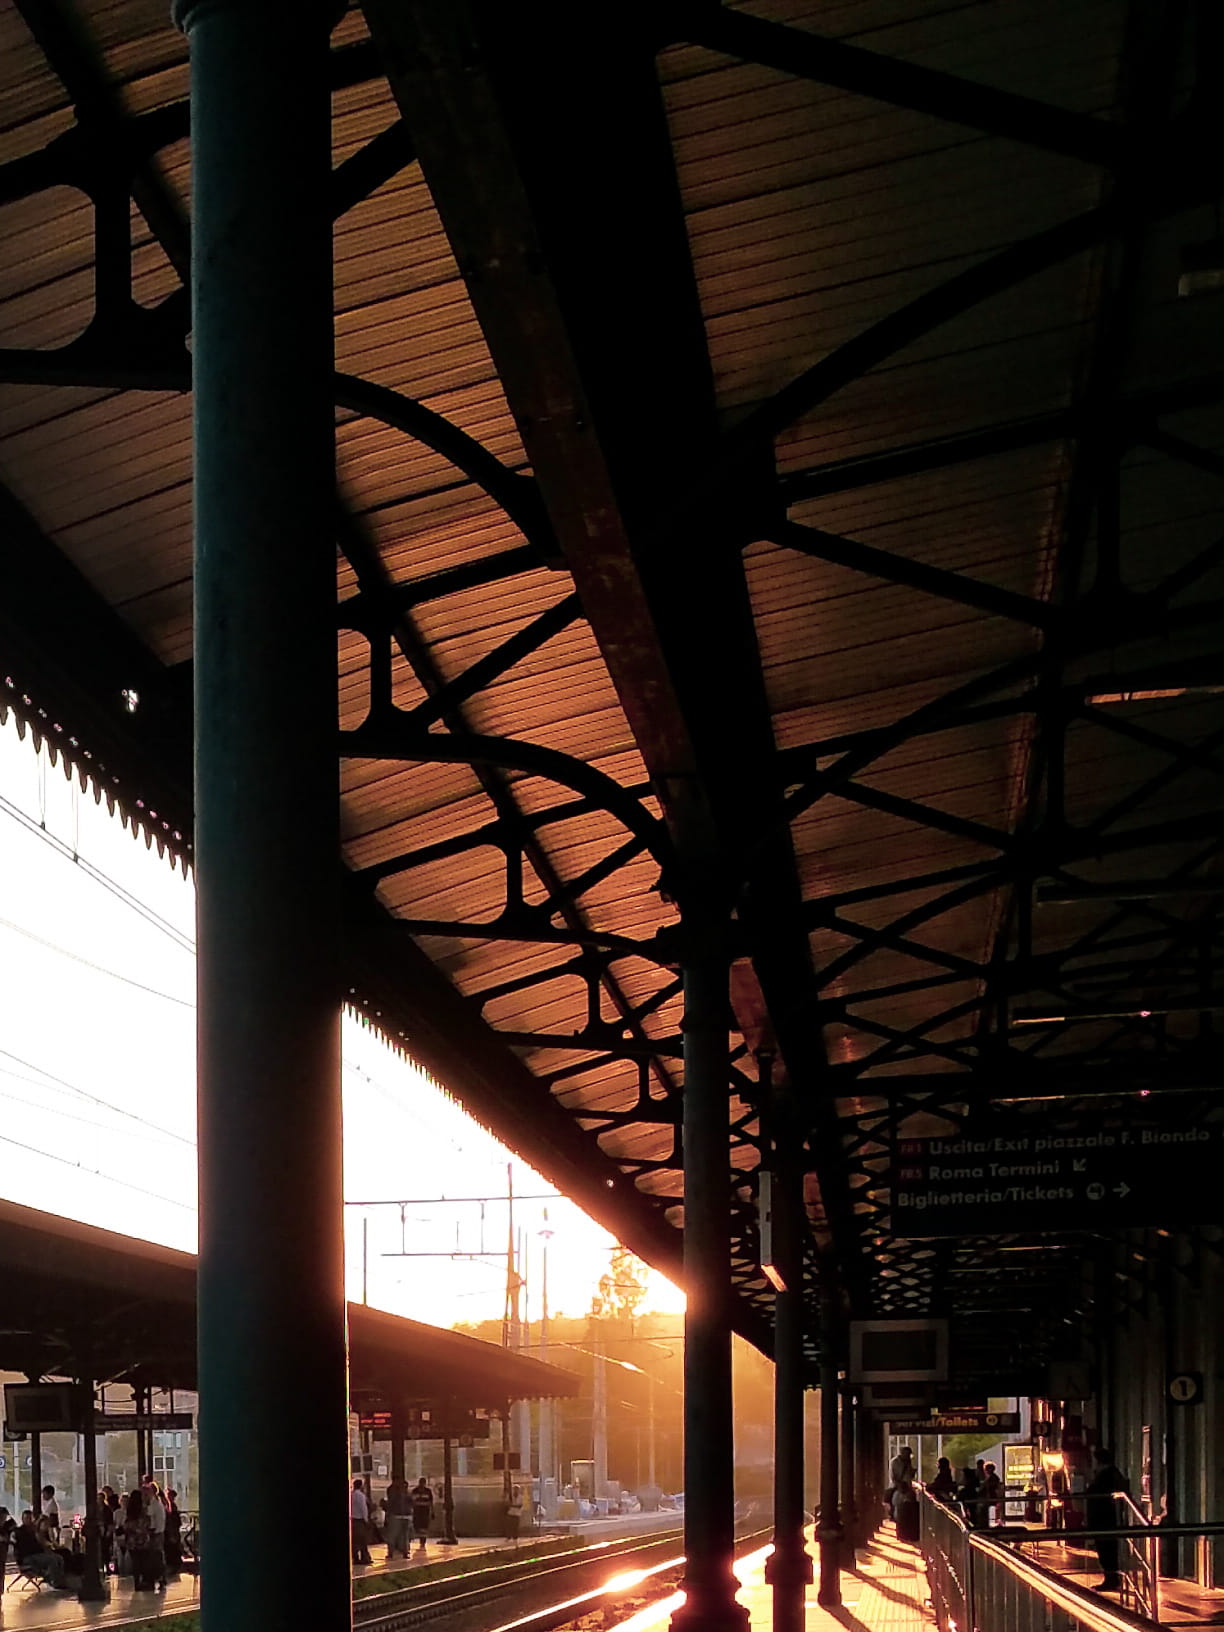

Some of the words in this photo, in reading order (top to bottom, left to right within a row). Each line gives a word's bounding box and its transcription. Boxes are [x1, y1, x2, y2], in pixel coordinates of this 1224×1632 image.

[929, 1137, 1028, 1155] Uscita/Exit
[1033, 1131, 1115, 1152] piazzale
[1120, 1129, 1136, 1145] F.
[1141, 1127, 1211, 1145] Biondo
[928, 1164, 985, 1181] Roma
[988, 1160, 1061, 1179] Termini
[897, 1186, 1075, 1210] Biglietteria/Tickets
